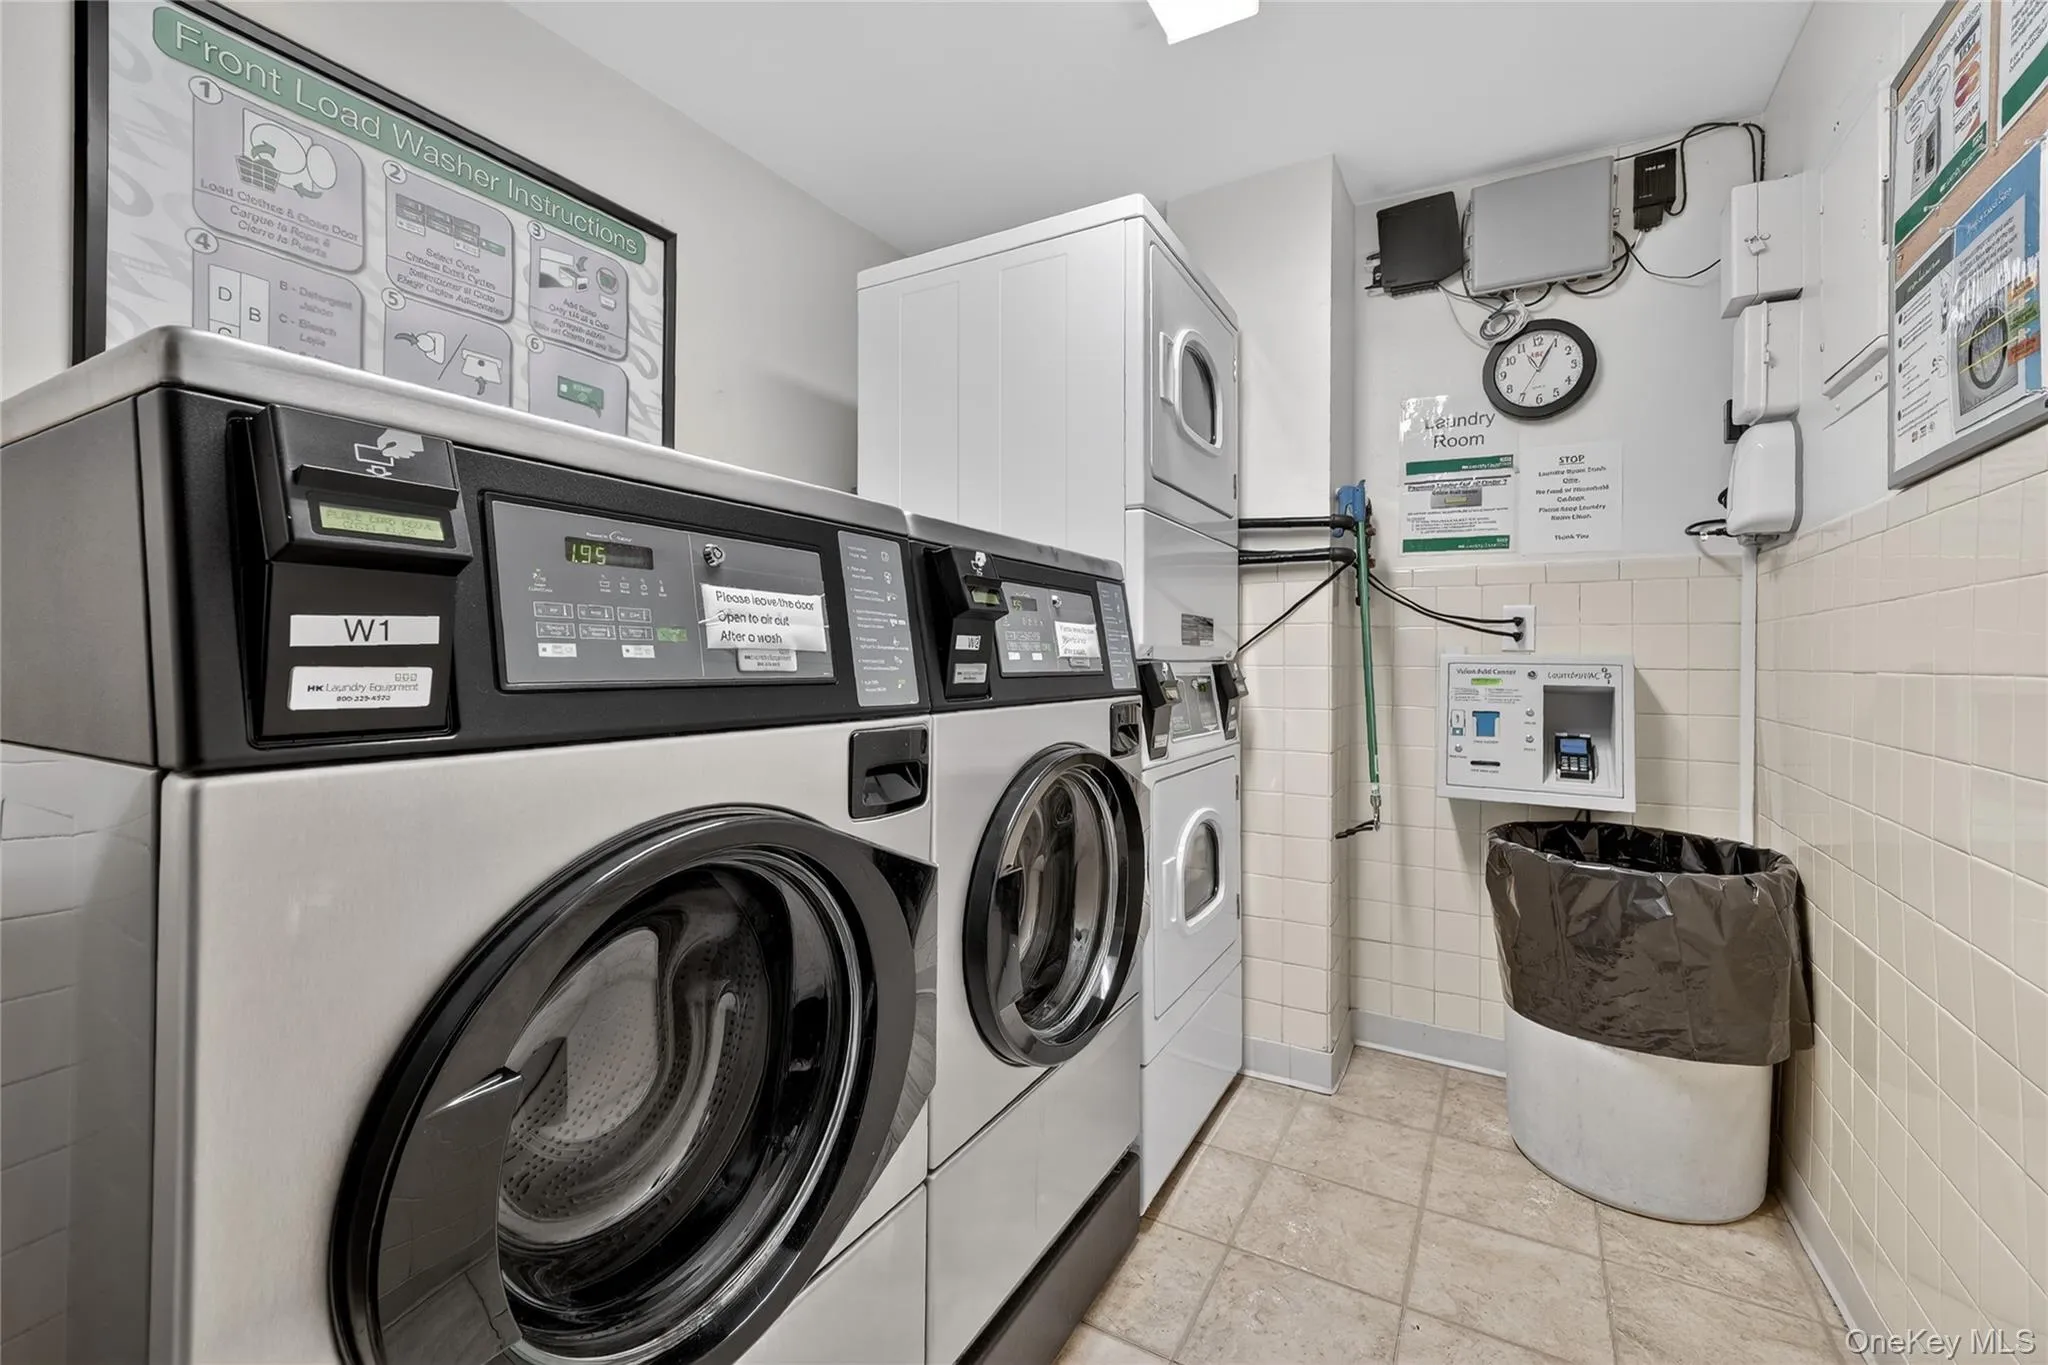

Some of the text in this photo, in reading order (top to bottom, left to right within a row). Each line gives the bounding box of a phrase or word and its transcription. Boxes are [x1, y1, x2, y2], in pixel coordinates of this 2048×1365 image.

[200, 81, 211, 98] 1
[176, 20, 638, 255] Front Load Washer Instructions
[390, 164, 401, 180] 2
[200, 178, 234, 198] Load
[237, 190, 284, 216] Clothes
[332, 224, 358, 242] Door
[230, 205, 274, 231] Cargue
[238, 220, 274, 241] Cierre
[532, 224, 540, 236] 3
[194, 232, 210, 250] 4
[218, 286, 232, 302] D
[388, 292, 399, 306] 5
[248, 306, 261, 323] B
[298, 318, 336, 337] Bleach
[530, 338, 539, 350] 6
[1532, 336, 1544, 346] 12
[1517, 344, 1526, 354] 11
[1564, 346, 1572, 356] 2
[1506, 356, 1516, 366] 10
[1570, 359, 1578, 368] 3
[1500, 371, 1507, 380] 9
[1564, 375, 1572, 386] 4
[1506, 384, 1513, 394] 8
[1552, 387, 1560, 398] 5
[1520, 392, 1526, 402] 7
[1536, 393, 1543, 404] 6
[1424, 411, 1496, 430] Laundry
[1433, 434, 1485, 448] Room
[1560, 455, 1584, 463] STOP
[572, 543, 606, 566] 1.95
[716, 590, 814, 611] Please leave the door
[718, 610, 790, 626] Open to air out
[344, 618, 390, 642] W1
[720, 629, 782, 644] After a wash
[307, 682, 419, 694] HK Laundry Equipment
